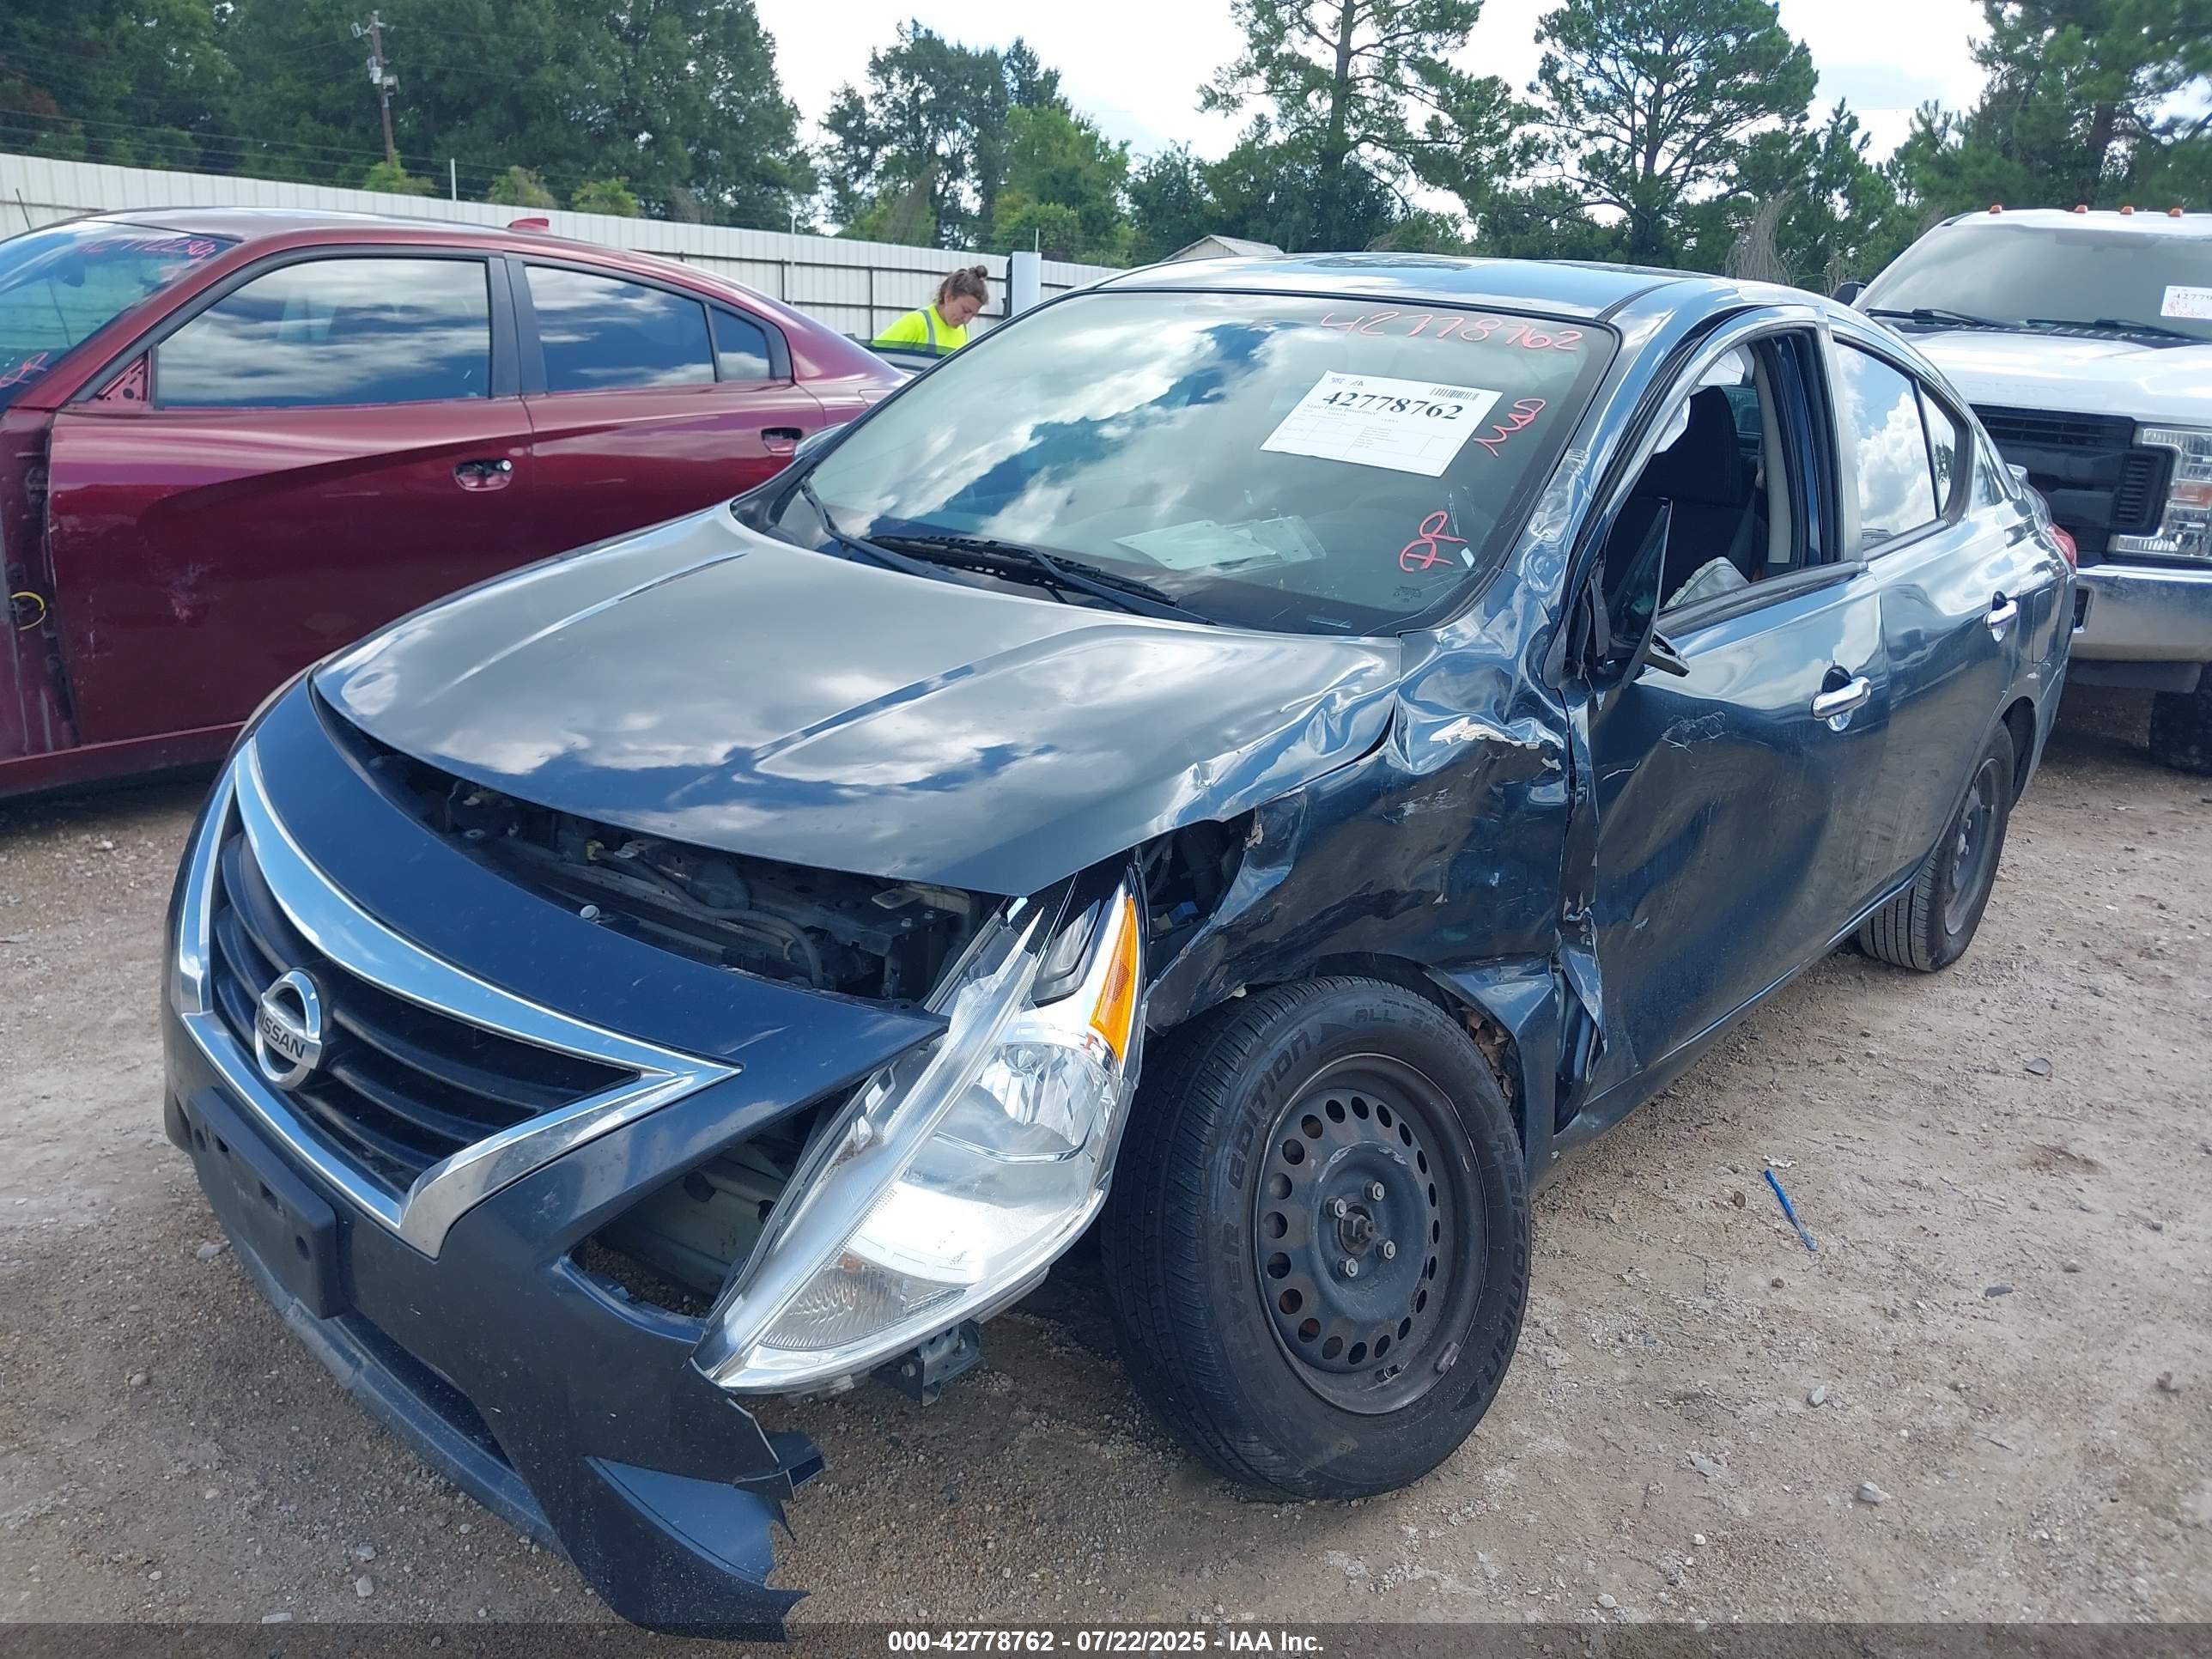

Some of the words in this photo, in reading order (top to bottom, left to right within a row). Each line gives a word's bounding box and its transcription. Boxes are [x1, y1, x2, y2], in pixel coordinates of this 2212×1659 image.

[1320, 311, 1583, 351] 42778762
[1322, 391, 1464, 420] 42778762
[258, 1009, 306, 1059] NISSAN
[1228, 1030, 1311, 1189] EDITION
